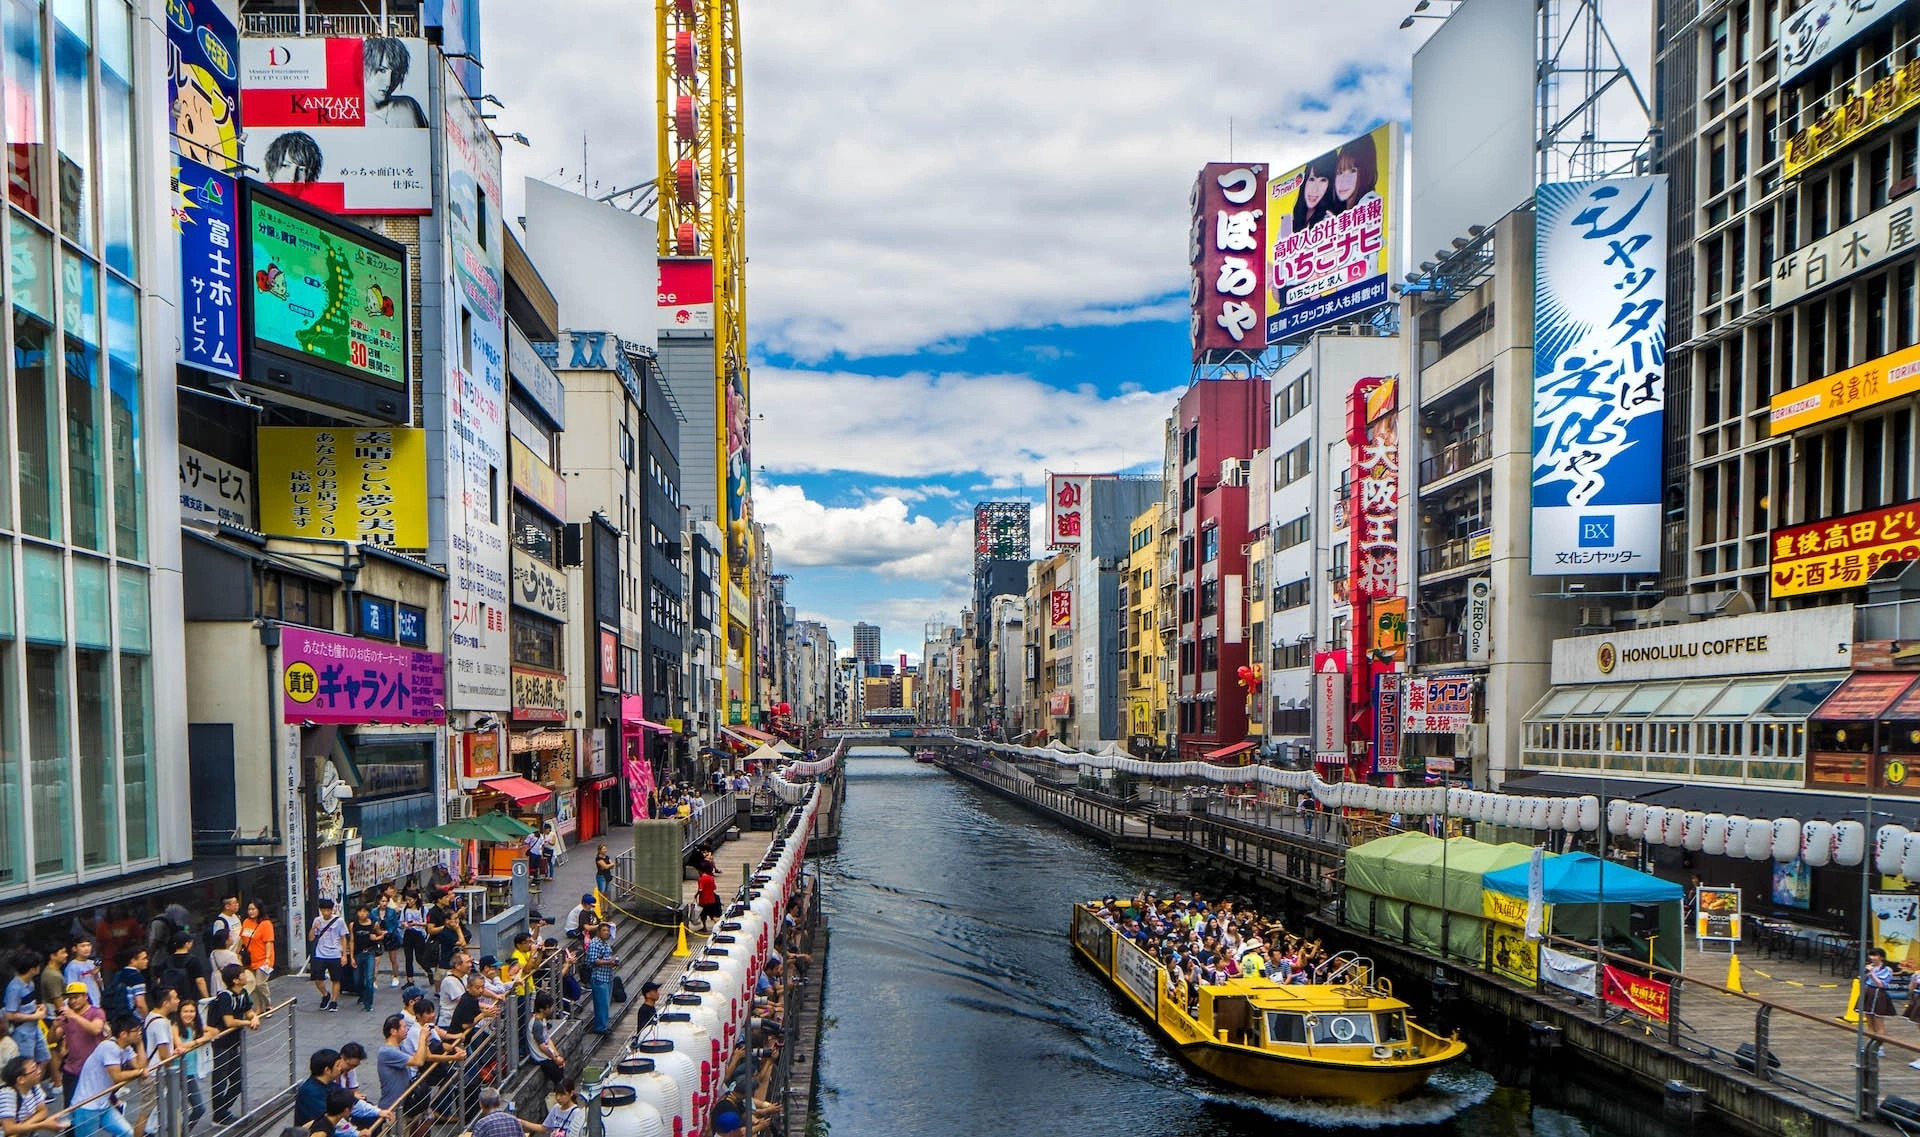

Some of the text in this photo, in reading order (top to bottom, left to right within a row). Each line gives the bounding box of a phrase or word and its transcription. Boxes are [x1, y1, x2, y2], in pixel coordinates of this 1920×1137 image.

[290, 94, 359, 113] KANZAKI
[317, 107, 360, 123] RUKA
[340, 167, 414, 177] めっちゃ面白いを
[393, 179, 424, 190] 仕事に。
[1273, 198, 1383, 260] 高収入お仕事情報
[1216, 164, 1263, 342] づぼらや
[1274, 218, 1382, 287] いちごナビ
[1776, 206, 1916, 290] 4F 白木屋
[207, 216, 234, 368] 富士ホーム
[1289, 274, 1343, 300] いちごナビ 求人
[190, 275, 207, 355] サービス
[351, 340, 367, 368] 30
[289, 471, 312, 528] 応援します
[316, 432, 337, 537] あなたのお店づくり
[353, 431, 397, 546] 素晴らしい夢の実現
[1359, 437, 1398, 597] 大阪王将
[1584, 523, 1610, 539] BX
[1795, 554, 1864, 588] 酒場
[369, 604, 379, 630] 酒
[453, 600, 478, 625] コスパ
[1053, 596, 1061, 620] ドラッグ
[1060, 592, 1069, 615] ツルハ
[1473, 600, 1484, 631] ZERO
[1621, 635, 1768, 663] HONOLULU COFFEE
[288, 671, 314, 694] 賃貸
[319, 663, 411, 710] ギャラント
[1409, 681, 1469, 712] 薬 ダイコク
[1383, 694, 1395, 735] ダイコク
[1425, 715, 1451, 731] 免税
